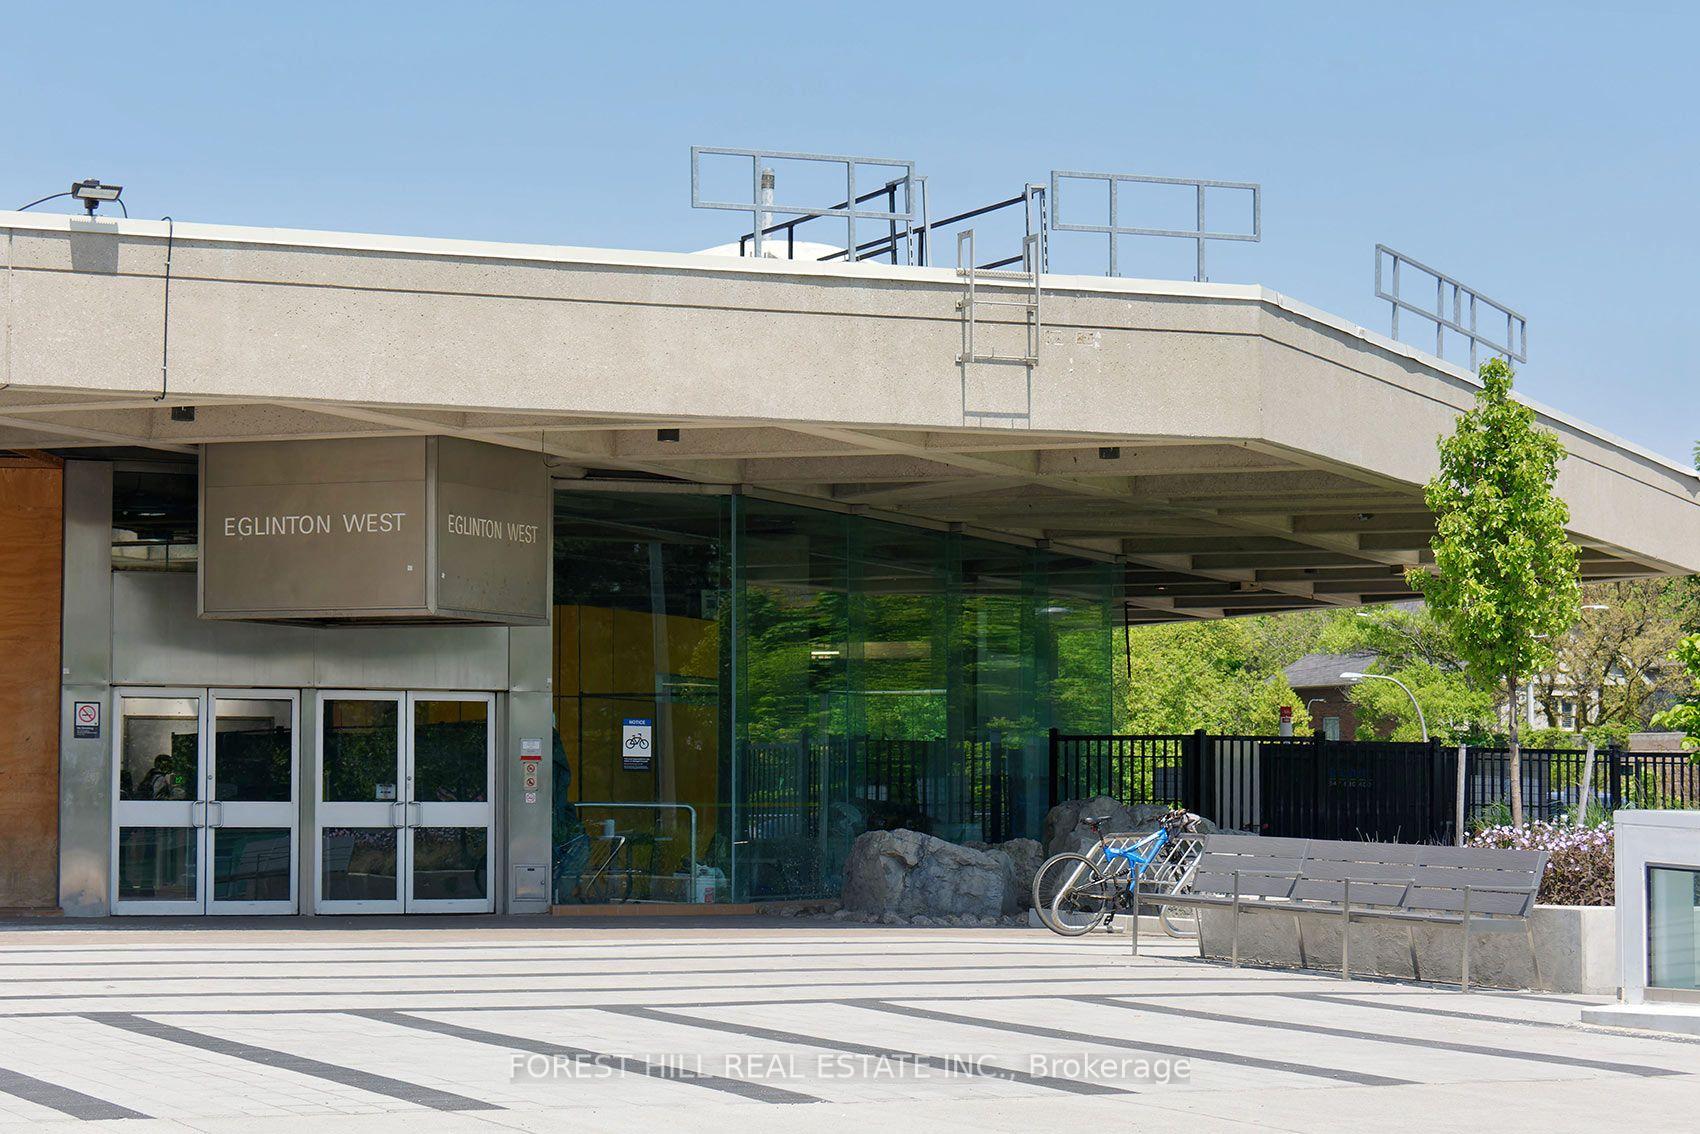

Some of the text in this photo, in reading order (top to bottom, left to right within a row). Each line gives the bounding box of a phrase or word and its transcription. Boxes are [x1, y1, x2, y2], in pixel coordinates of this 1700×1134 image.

[224, 512, 406, 536] EGLINTON WEST
[448, 514, 538, 544] EGLINTON WEST
